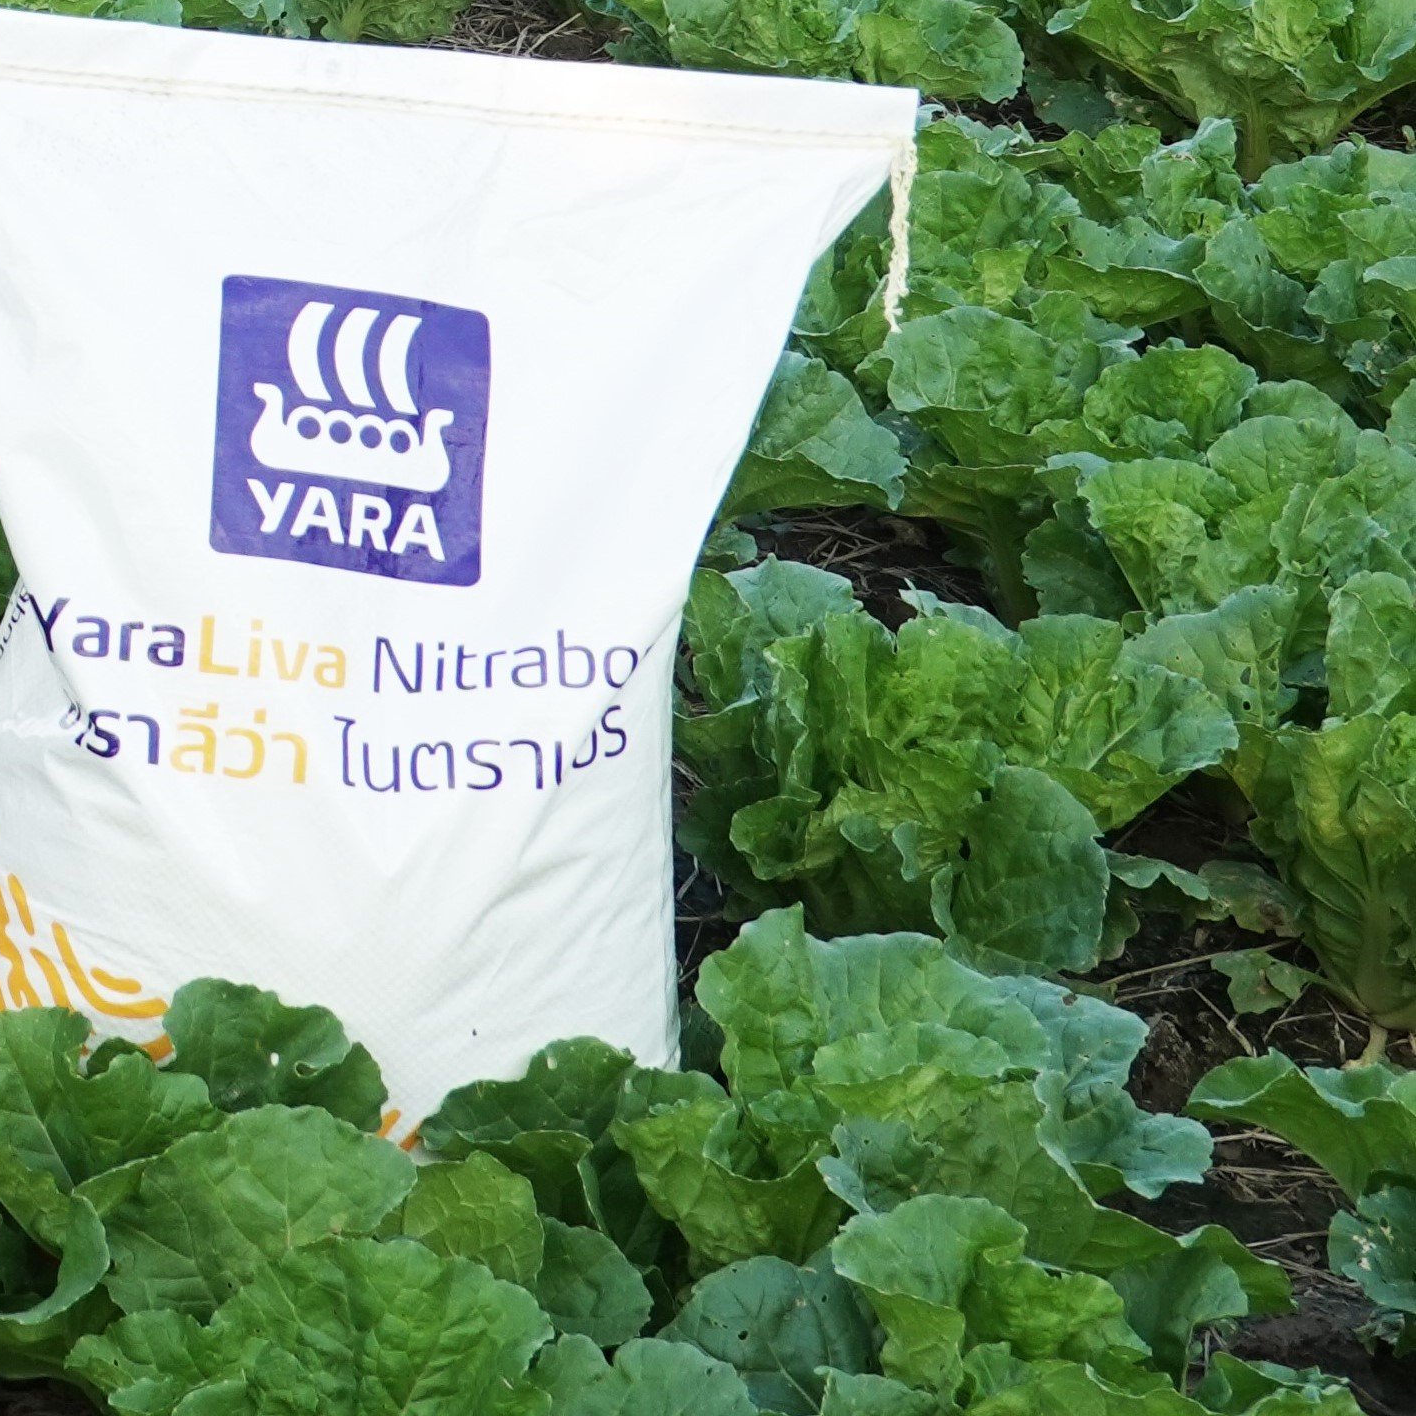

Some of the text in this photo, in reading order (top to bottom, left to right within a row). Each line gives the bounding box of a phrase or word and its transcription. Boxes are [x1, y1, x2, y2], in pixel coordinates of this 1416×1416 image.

[246, 478, 446, 563] YARA
[28, 597, 347, 689] YaraLiva
[373, 629, 654, 694] Nitrabo
